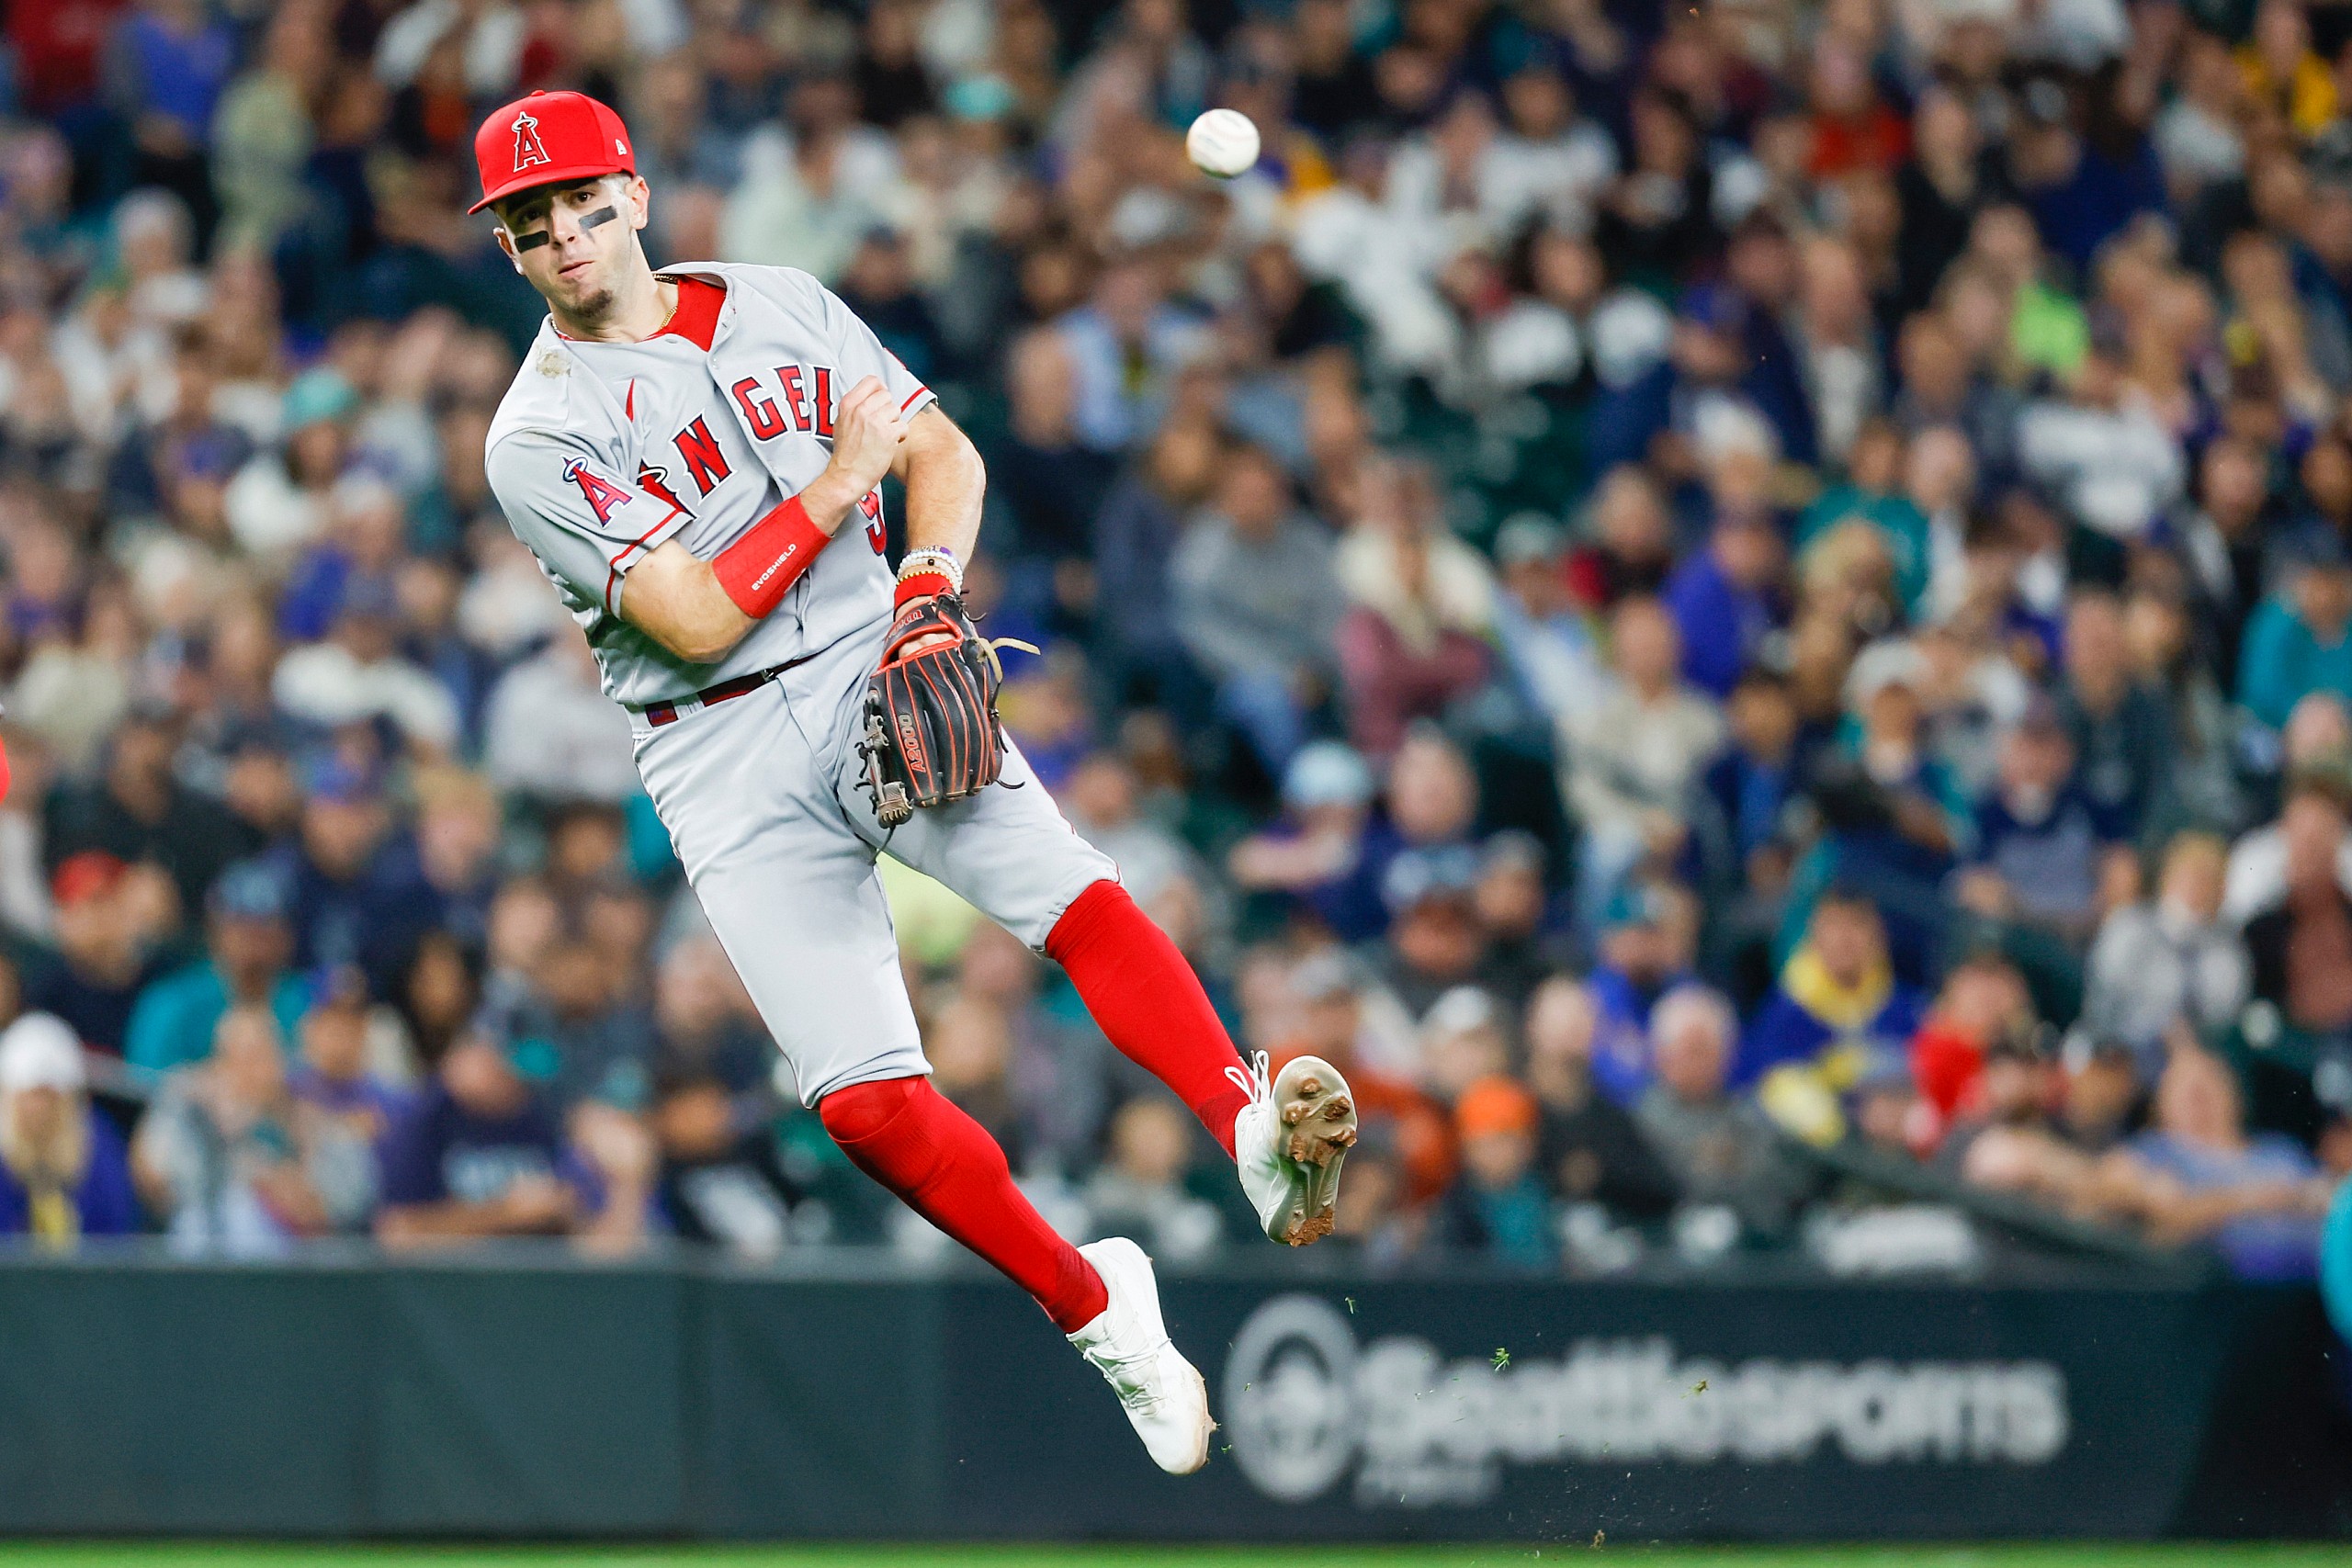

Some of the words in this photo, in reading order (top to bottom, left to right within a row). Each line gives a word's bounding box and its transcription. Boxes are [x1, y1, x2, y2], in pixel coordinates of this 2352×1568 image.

[512, 111, 552, 173] A
[560, 453, 636, 530] A
[898, 713, 927, 773] A2000
